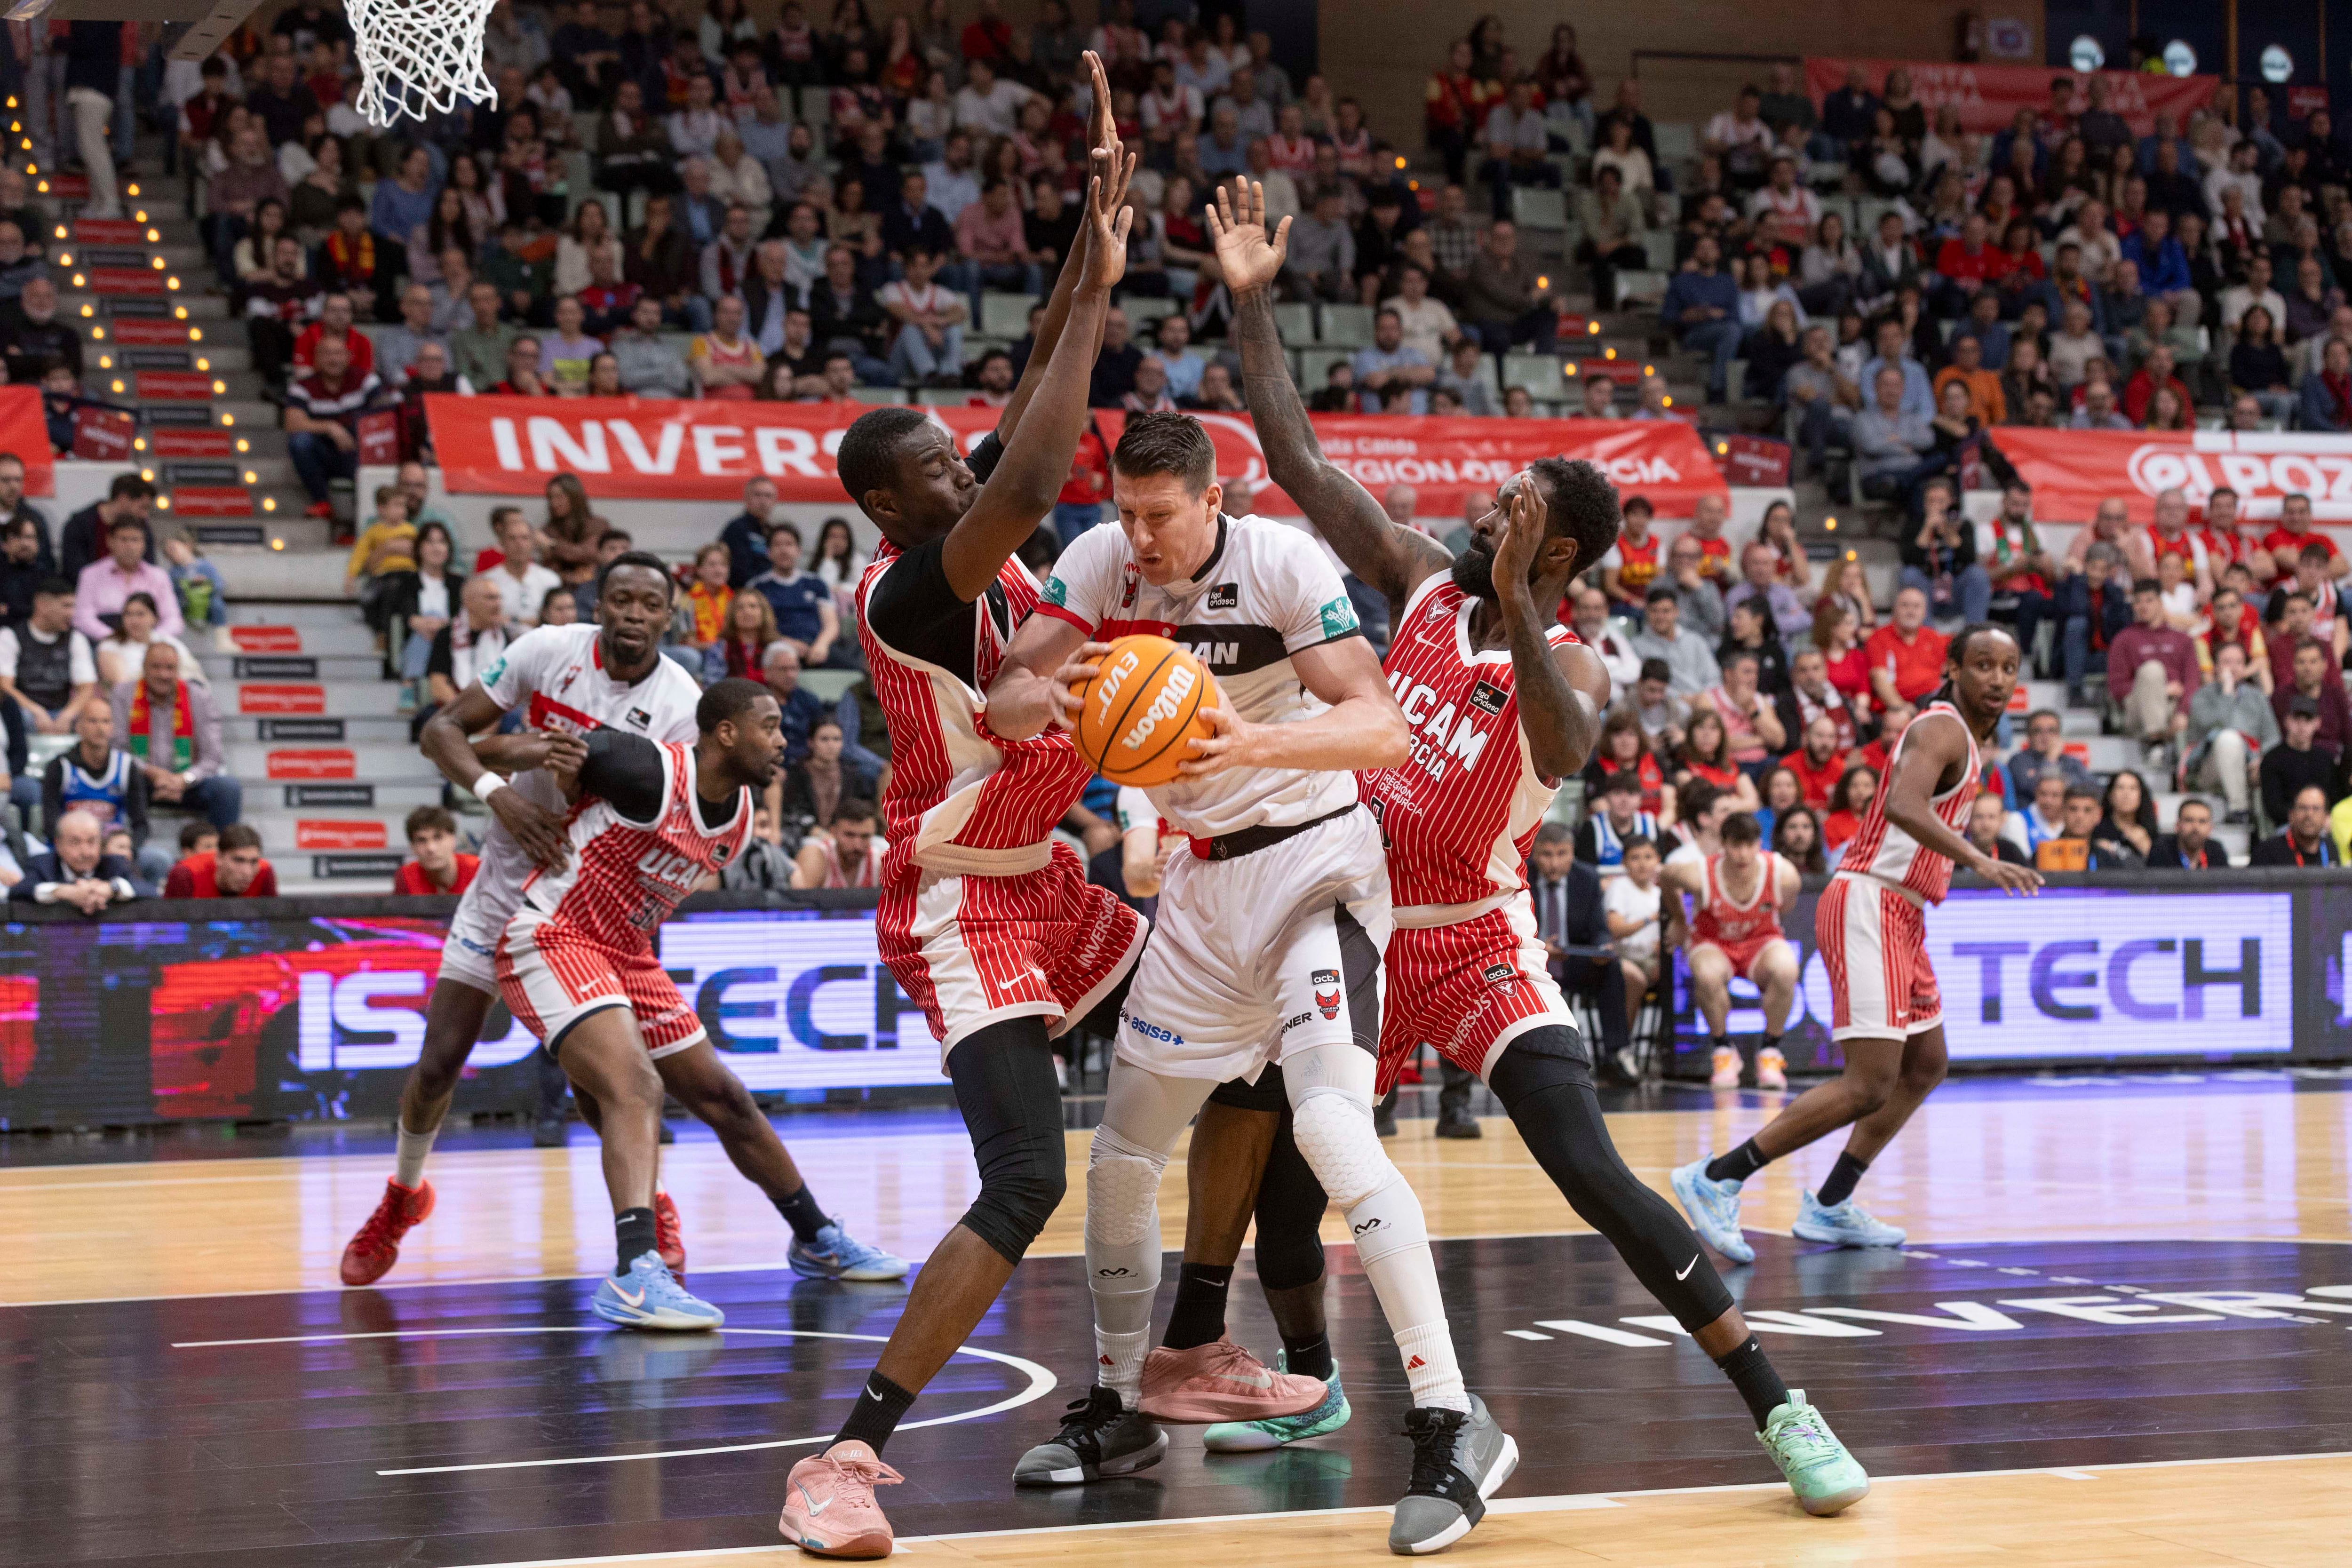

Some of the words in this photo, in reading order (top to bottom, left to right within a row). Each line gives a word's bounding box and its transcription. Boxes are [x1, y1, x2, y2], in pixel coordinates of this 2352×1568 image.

[1210, 598, 1235, 606] endesa
[1211, 591, 1222, 600] liga
[1098, 651, 1139, 708] EVO
[1476, 688, 1490, 700] liga
[1121, 664, 1196, 750] Wilson
[1473, 696, 1500, 713] endesa
[1389, 790, 1423, 817] MURCIA
[637, 848, 708, 890] UCA
[1077, 893, 1117, 968] INVERSUS
[1314, 974, 1335, 984] acb
[1488, 968, 1508, 980] acb
